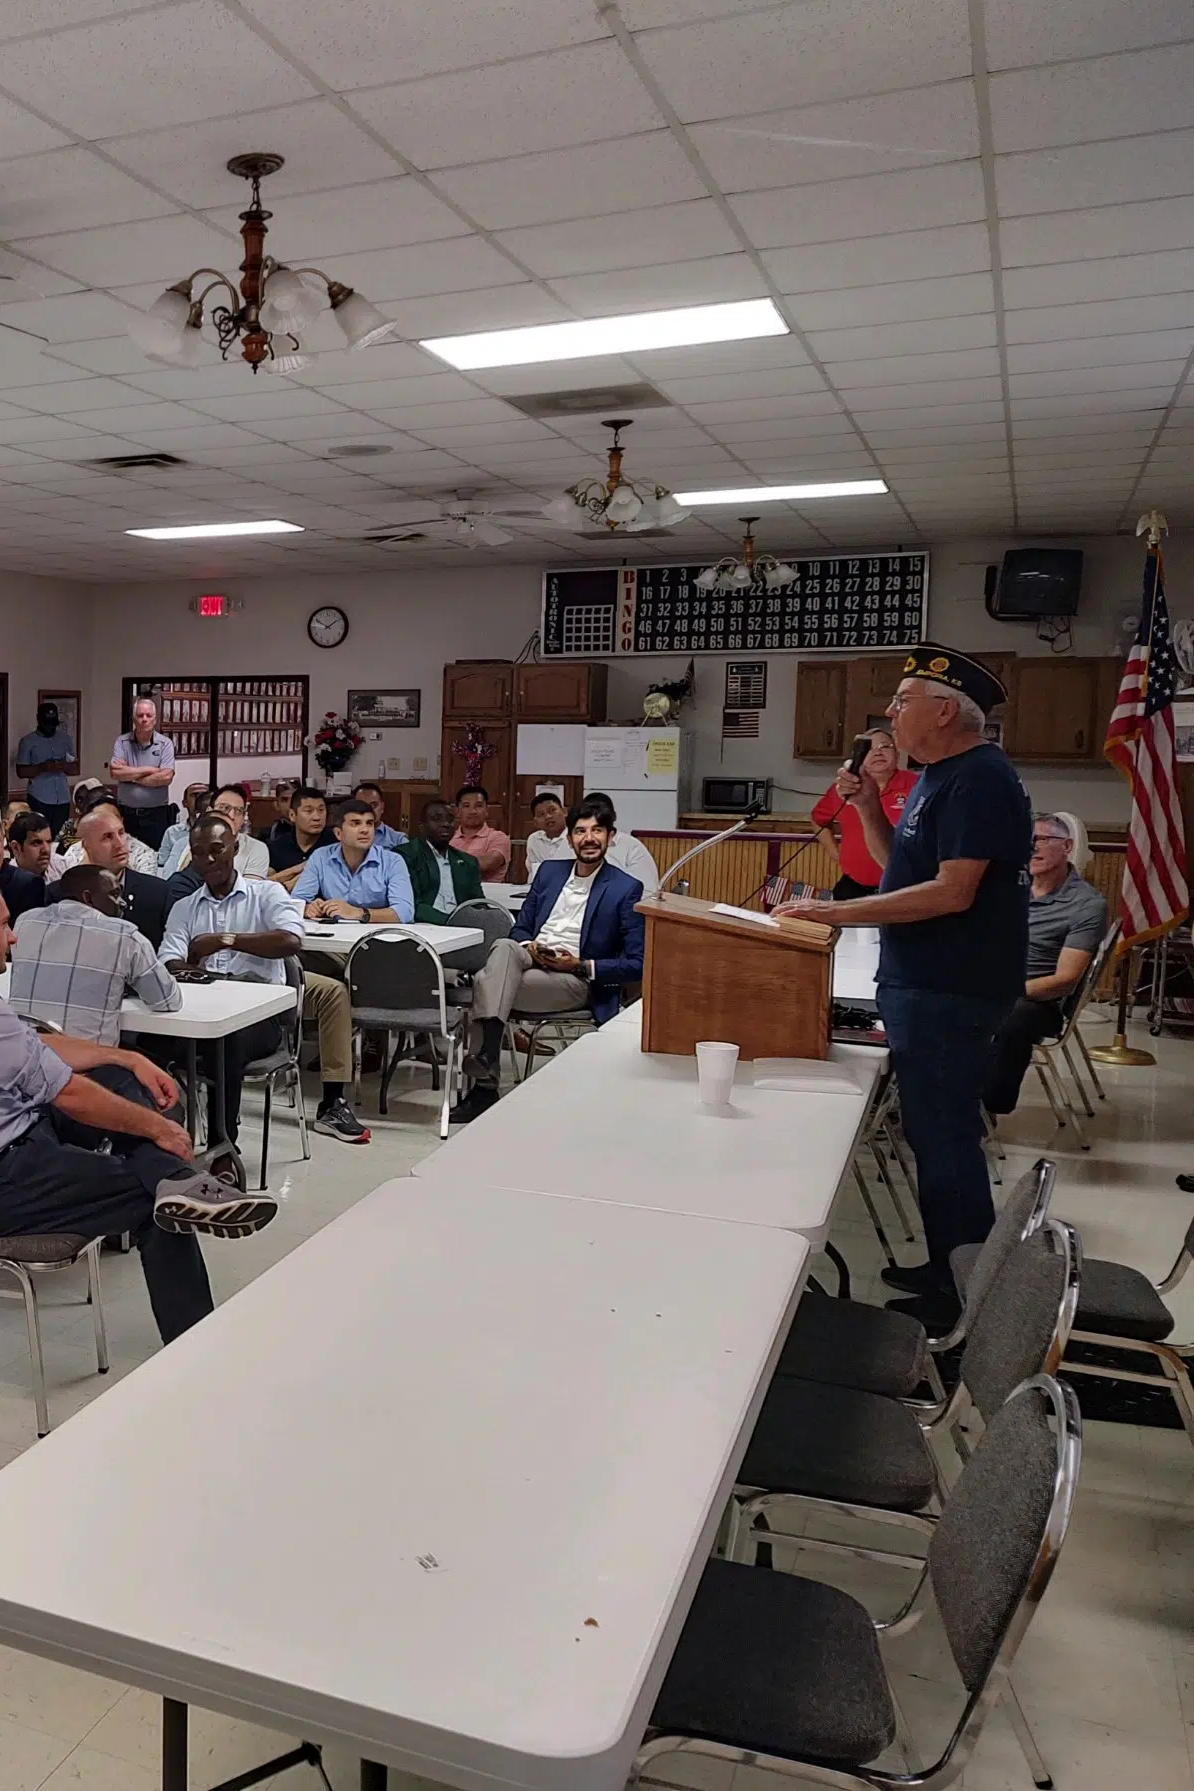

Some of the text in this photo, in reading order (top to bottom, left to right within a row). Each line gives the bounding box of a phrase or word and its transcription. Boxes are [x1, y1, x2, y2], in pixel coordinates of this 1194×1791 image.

[646, 571, 650, 582] 1
[662, 569, 669, 582] 2
[681, 569, 686, 581] 3
[809, 562, 820, 575] 10
[830, 561, 839, 574] 11
[848, 561, 859, 574] 12
[869, 560, 879, 573] 13
[889, 559, 900, 572] 14
[909, 558, 921, 571] 15
[642, 587, 652, 599] 16
[660, 586, 670, 599] 17
[678, 585, 688, 598] 18
[806, 580, 820, 593] 25
[825, 579, 840, 592] 26
[845, 578, 860, 592] 27
[865, 577, 880, 591] 28
[885, 576, 900, 590] 29
[906, 576, 921, 589] 30
[201, 596, 223, 615] EXIT
[621, 570, 635, 651] BINGO
[640, 594, 920, 617] 31 32 33 34 35 36 37 38 39 40 41 42 43 44 45
[638, 612, 919, 633] 46 47 48 49 50 51 52 53 54 55 56 57 58 59 60
[639, 630, 918, 650] 61 62 63 64 65 66 67 68 69 70 71 72 73 74 75
